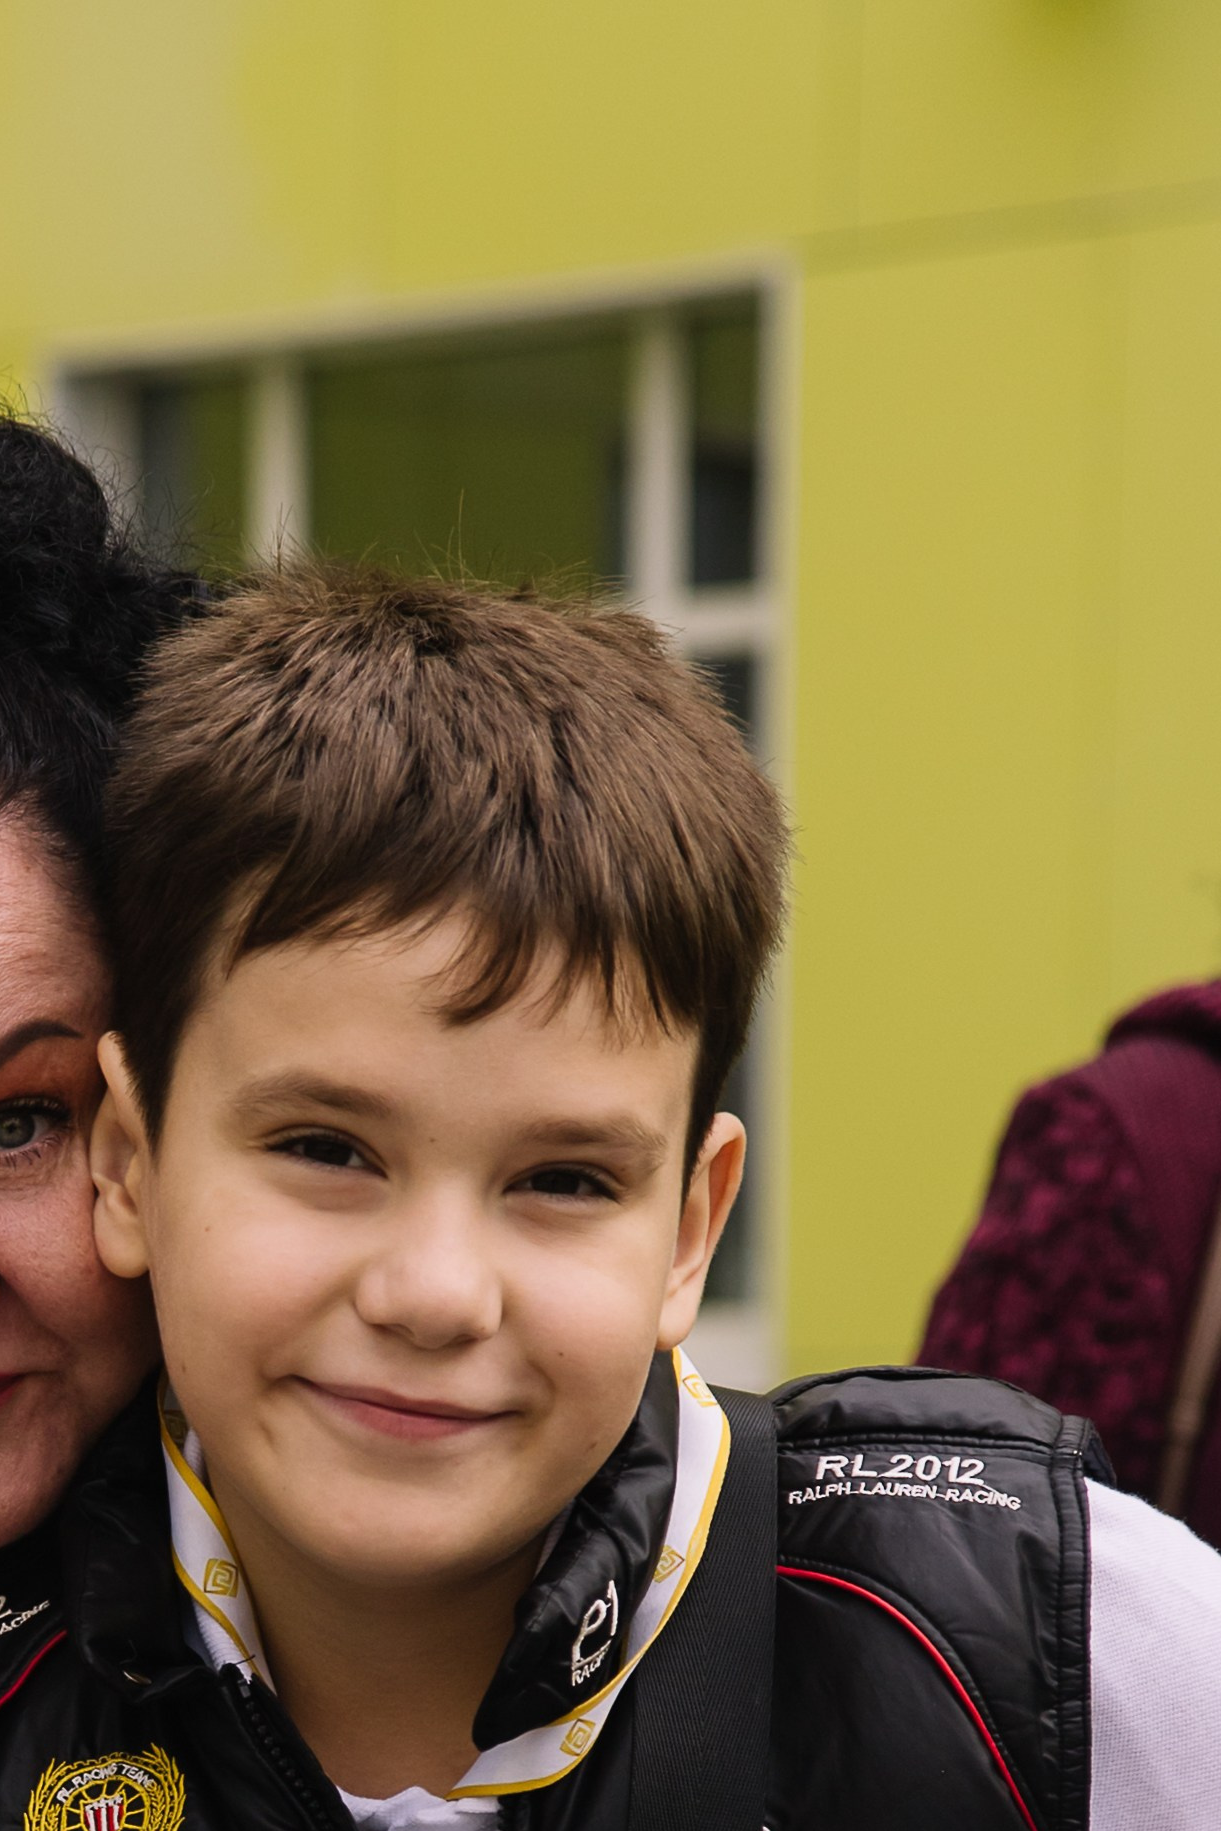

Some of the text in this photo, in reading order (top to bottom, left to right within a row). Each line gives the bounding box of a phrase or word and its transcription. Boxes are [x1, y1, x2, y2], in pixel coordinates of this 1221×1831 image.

[815, 1454, 985, 1486] RL 2012
[789, 1481, 1021, 1512] RALPH LAUREN RACING
